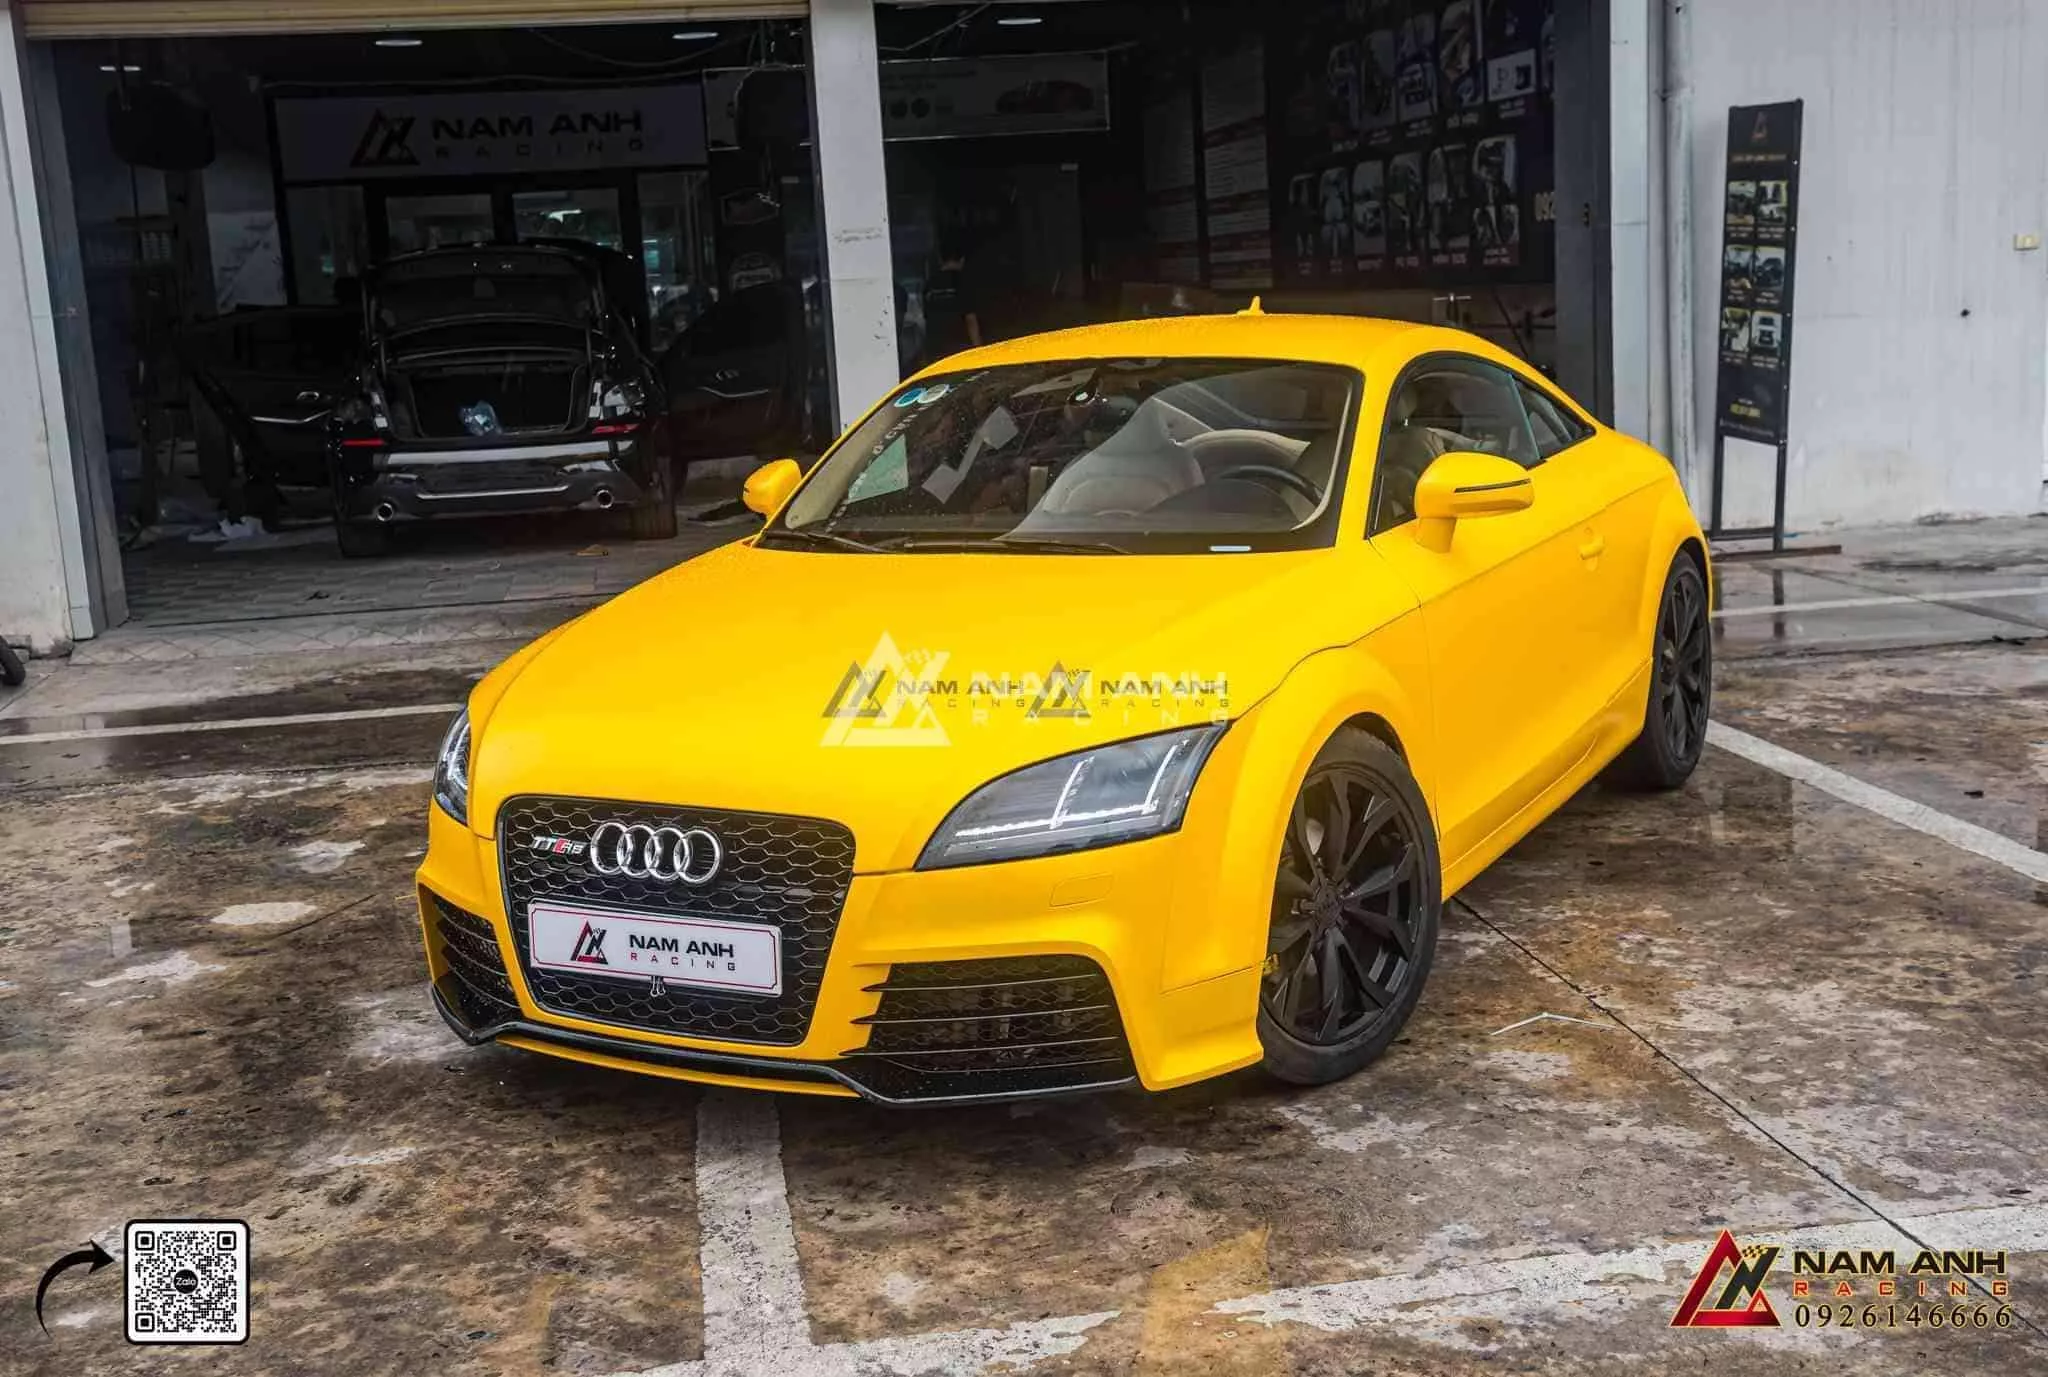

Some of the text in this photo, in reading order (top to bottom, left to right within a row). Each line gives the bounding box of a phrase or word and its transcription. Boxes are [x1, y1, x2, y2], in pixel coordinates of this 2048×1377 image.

[434, 111, 641, 139] NAM ANH
[435, 138, 645, 158] RACING
[628, 933, 734, 958] NAM ANH
[630, 952, 736, 972] RACING
